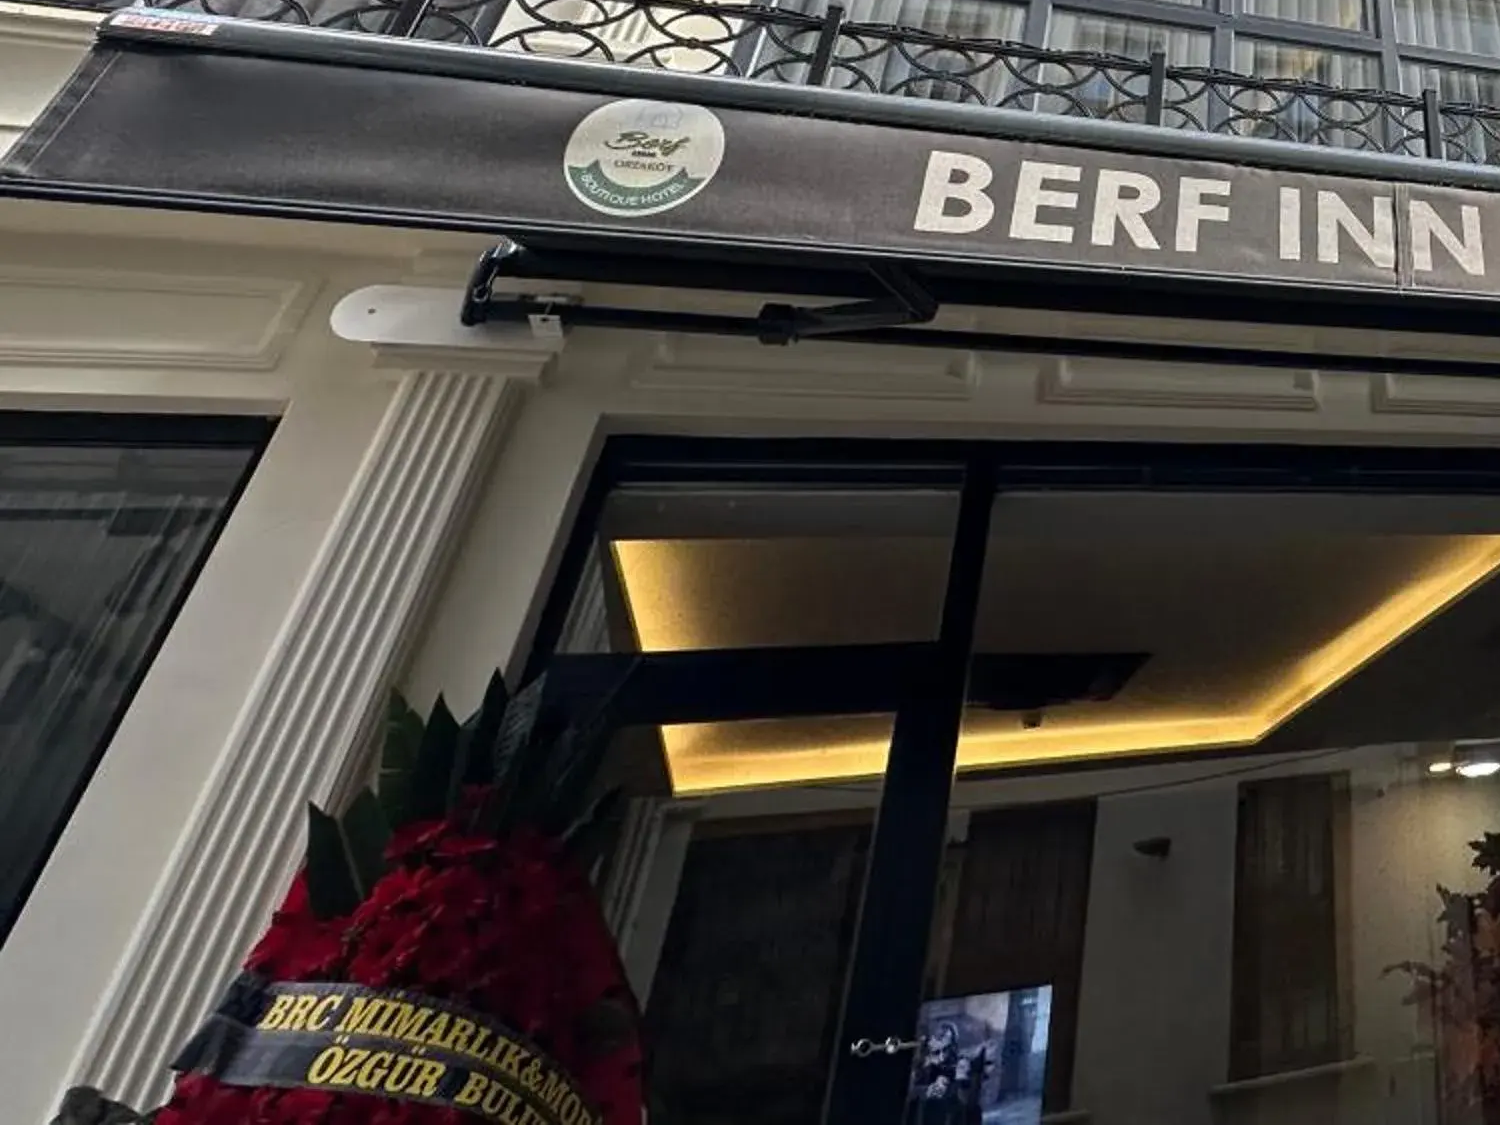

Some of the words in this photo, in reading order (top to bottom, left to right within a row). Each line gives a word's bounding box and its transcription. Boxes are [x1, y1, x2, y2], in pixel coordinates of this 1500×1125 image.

[580, 170, 638, 206] BOUTIQUE
[640, 182, 684, 205] HOTEL
[913, 149, 1231, 253] BERF
[1278, 186, 1486, 276] INN
[256, 994, 340, 1031] BRC
[305, 1034, 448, 1097] ÖZGÜR
